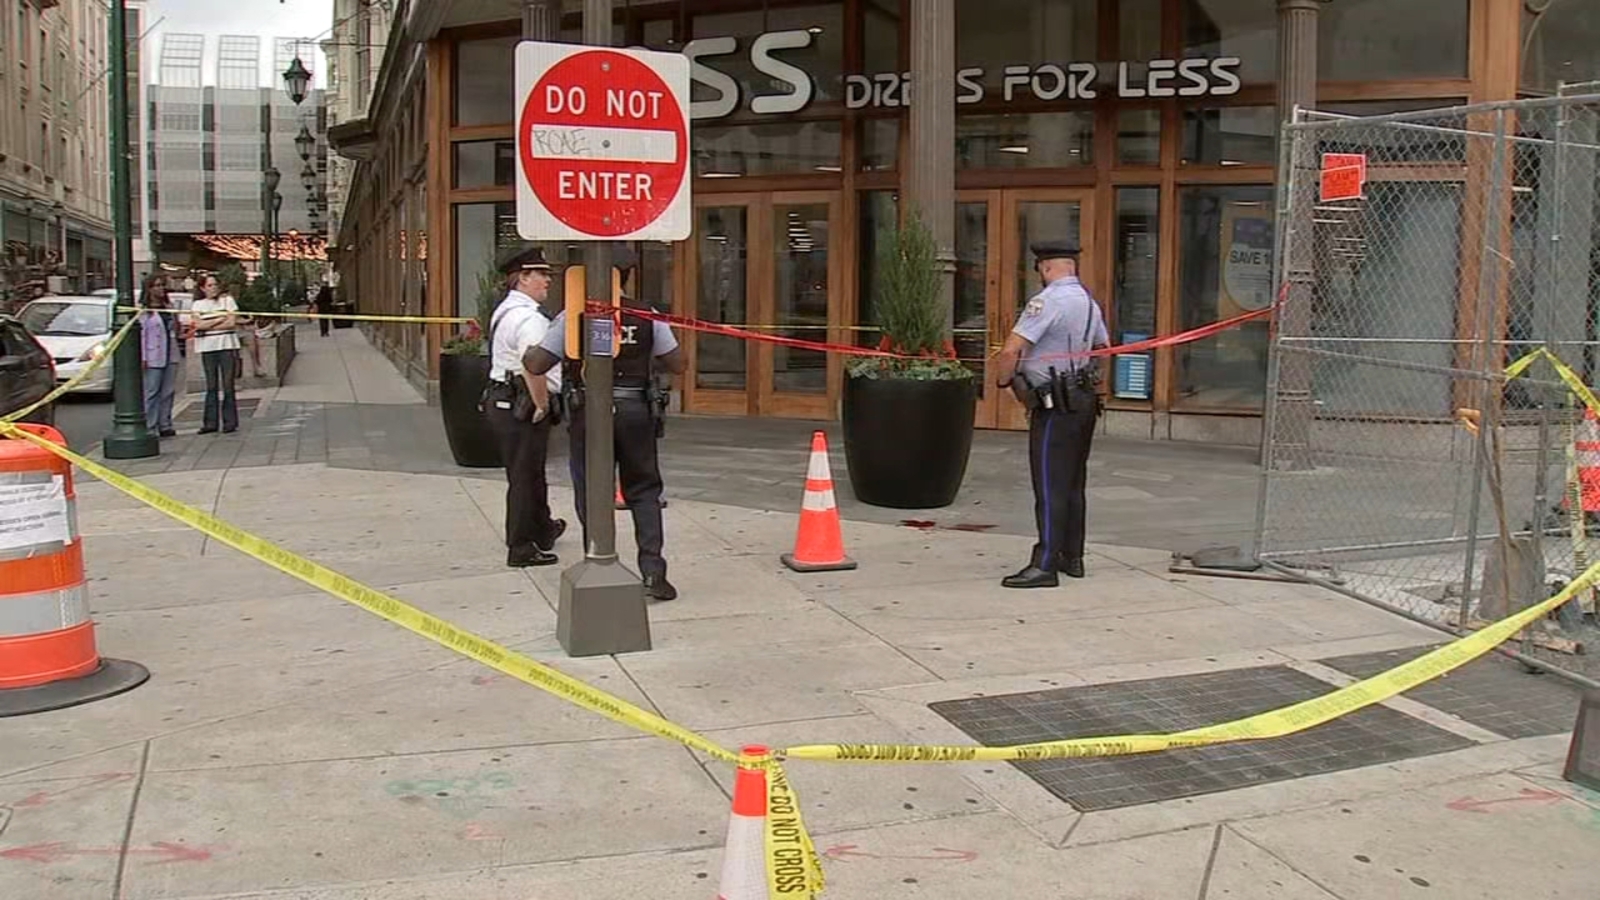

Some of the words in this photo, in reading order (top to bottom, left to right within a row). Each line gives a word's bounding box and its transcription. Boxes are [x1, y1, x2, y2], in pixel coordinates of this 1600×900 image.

[682, 29, 812, 120] SS
[846, 67, 984, 109] DRS
[1004, 63, 1097, 101] FOR
[1119, 57, 1241, 98] LESS
[546, 86, 586, 115] DO
[607, 91, 663, 119] NOT
[559, 171, 653, 200] ENTER
[1229, 251, 1261, 264] SAVE
[770, 796, 794, 814] DO
[772, 818, 801, 844] NOT
[773, 848, 806, 893] CROSS
